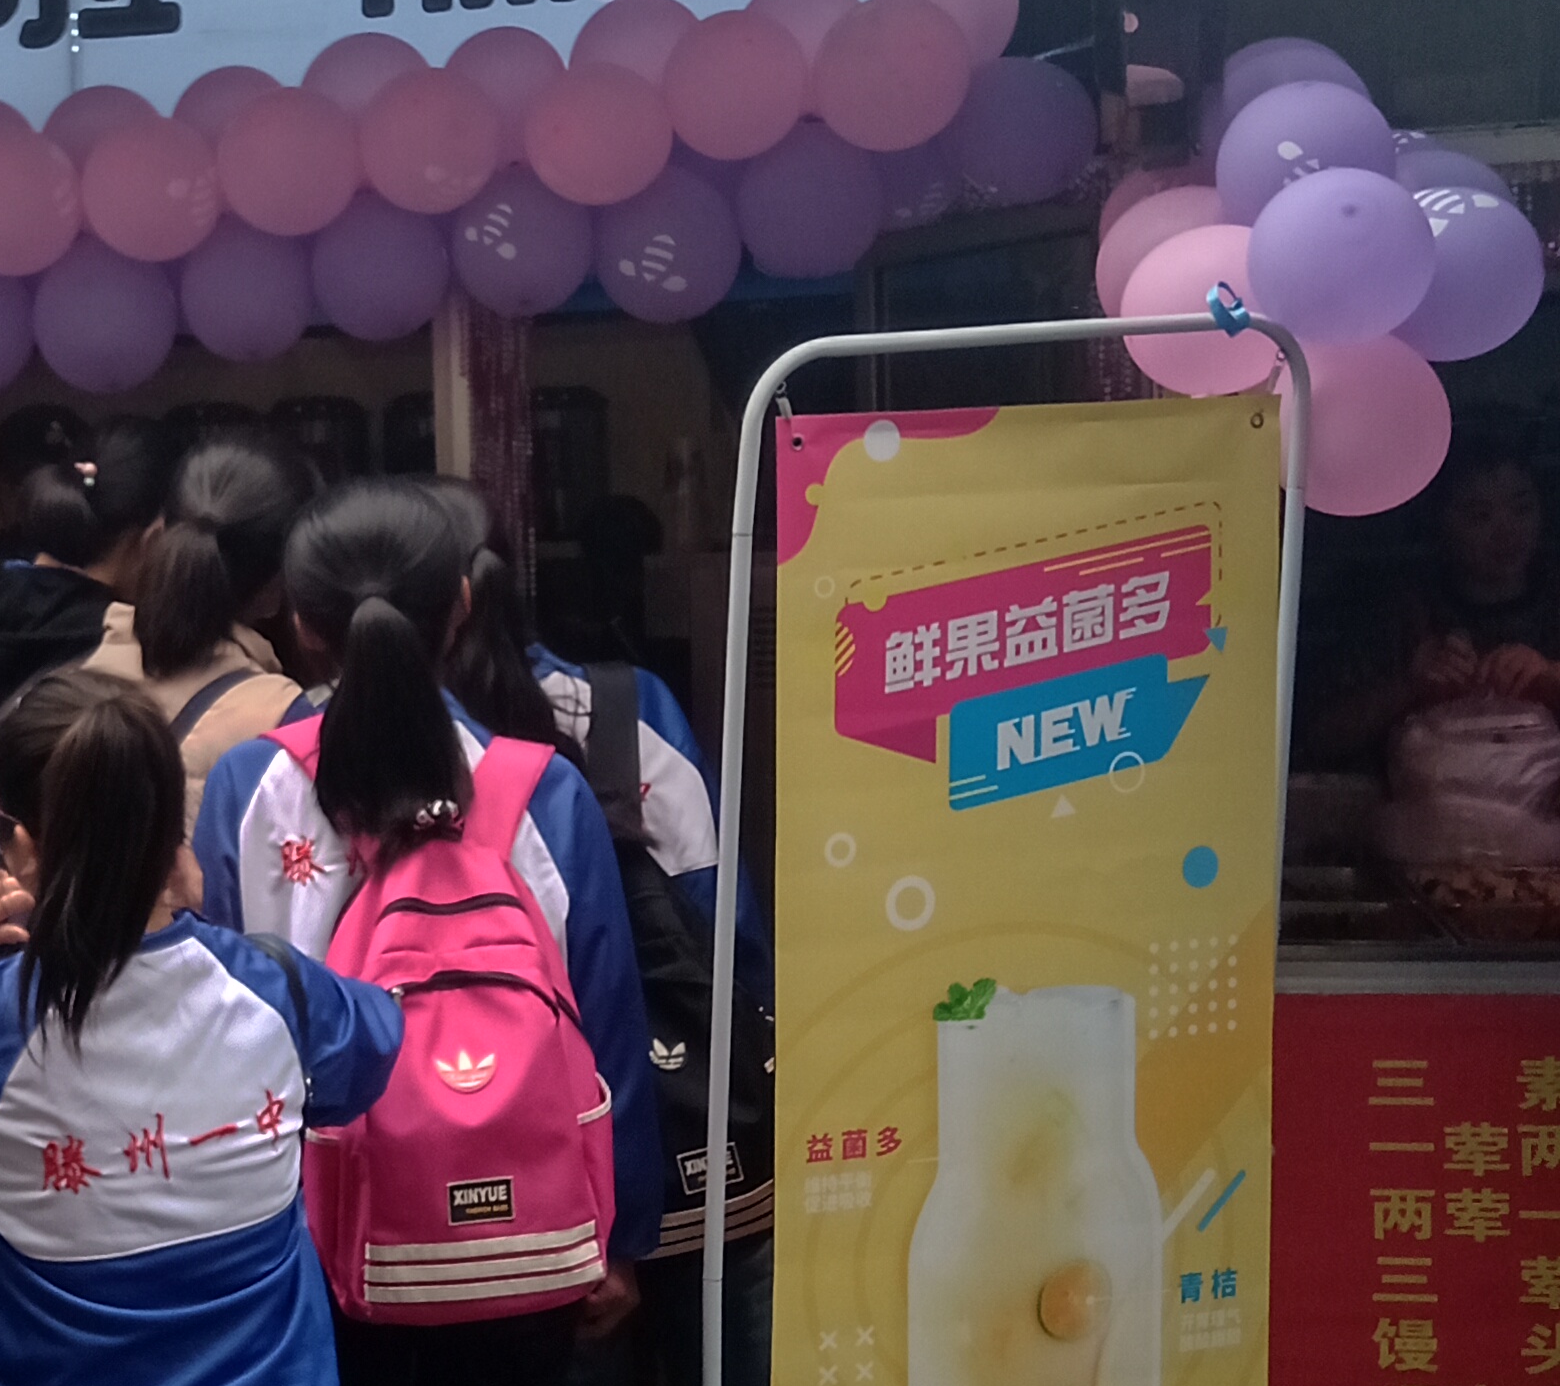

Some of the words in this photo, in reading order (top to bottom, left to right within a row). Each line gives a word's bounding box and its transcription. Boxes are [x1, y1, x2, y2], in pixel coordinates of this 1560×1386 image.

[885, 571, 1170, 693] 鲜果益菌多
[996, 687, 1138, 771] NEW
[805, 1126, 903, 1164] 益菌多
[453, 1184, 508, 1206] XINYUE
[1179, 1267, 1238, 1304] 青桔
